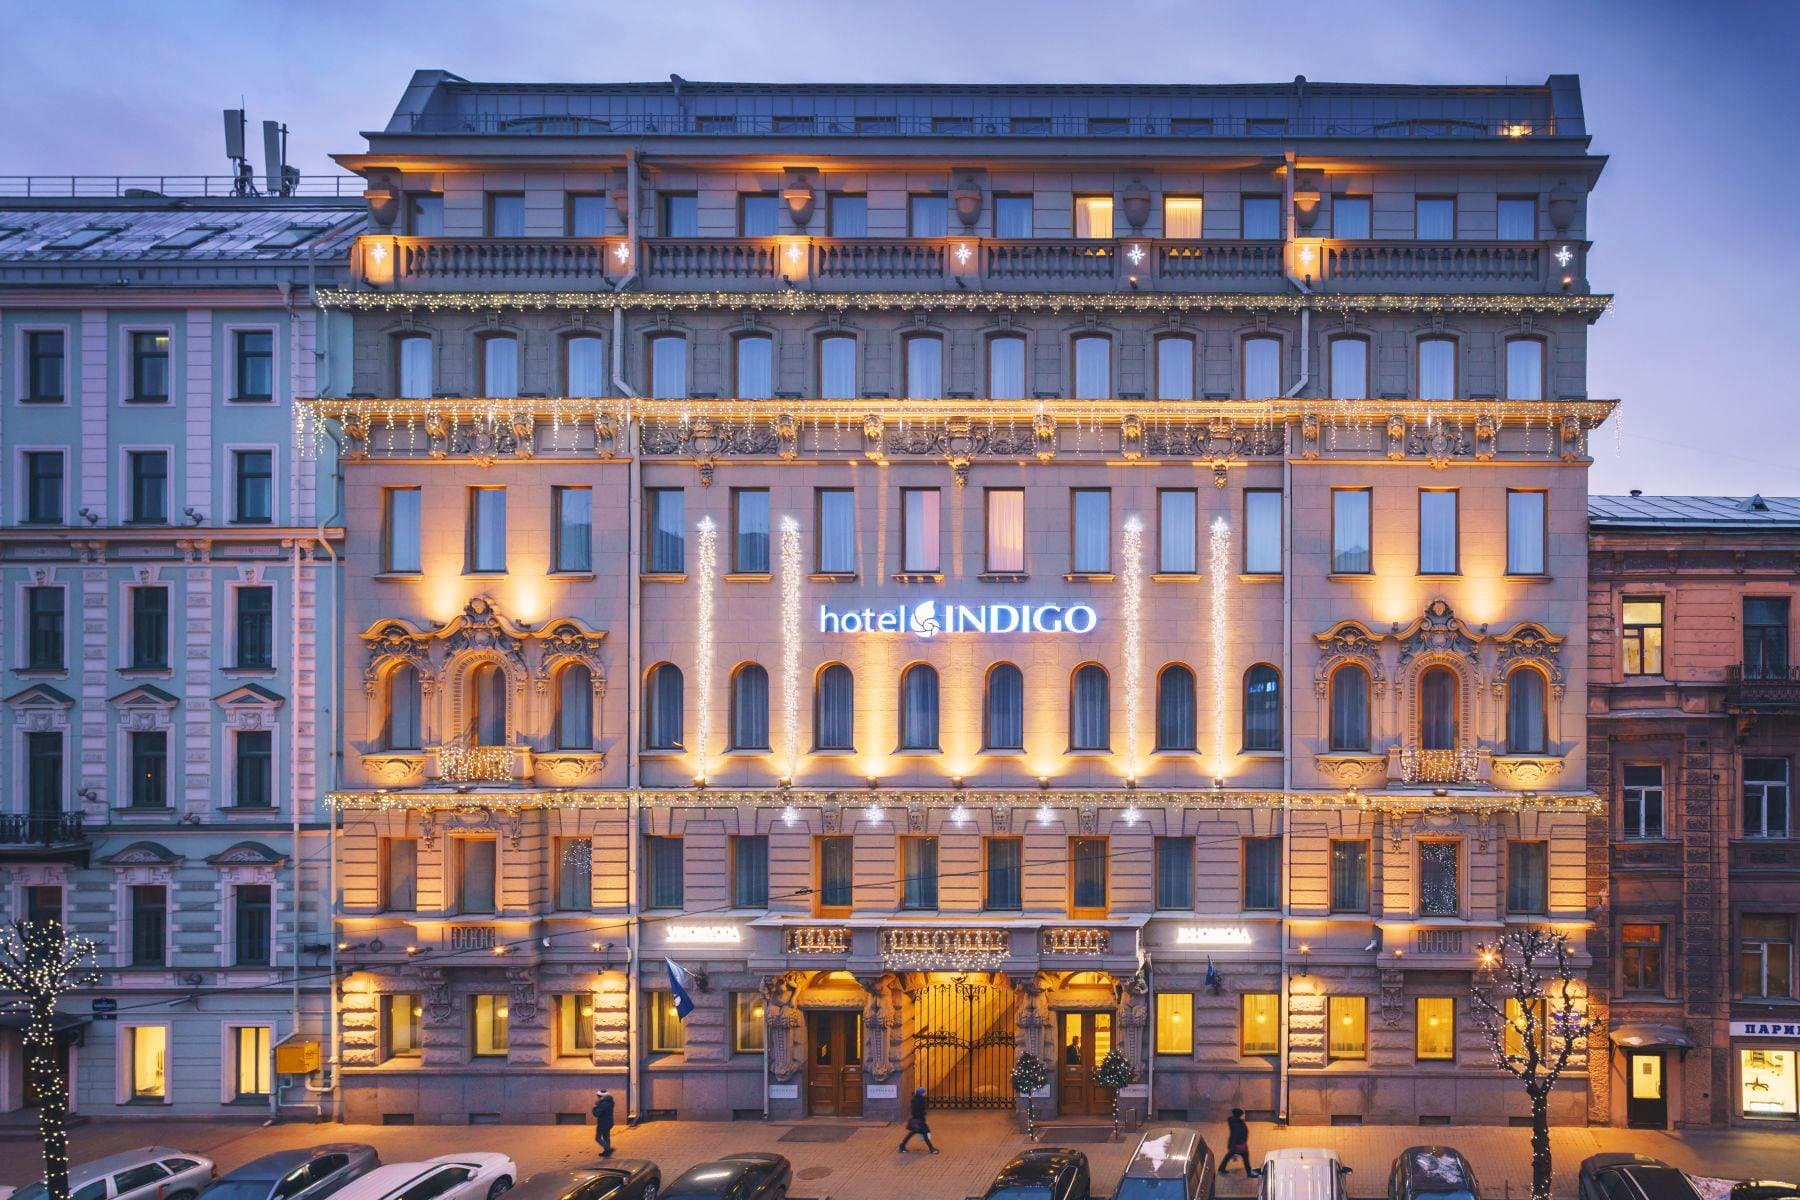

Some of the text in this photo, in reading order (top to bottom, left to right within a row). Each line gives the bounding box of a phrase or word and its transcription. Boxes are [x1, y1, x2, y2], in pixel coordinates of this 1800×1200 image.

[820, 604, 1097, 634] hotel INDIGO
[1744, 1024, 1800, 1036] ПАРИ
